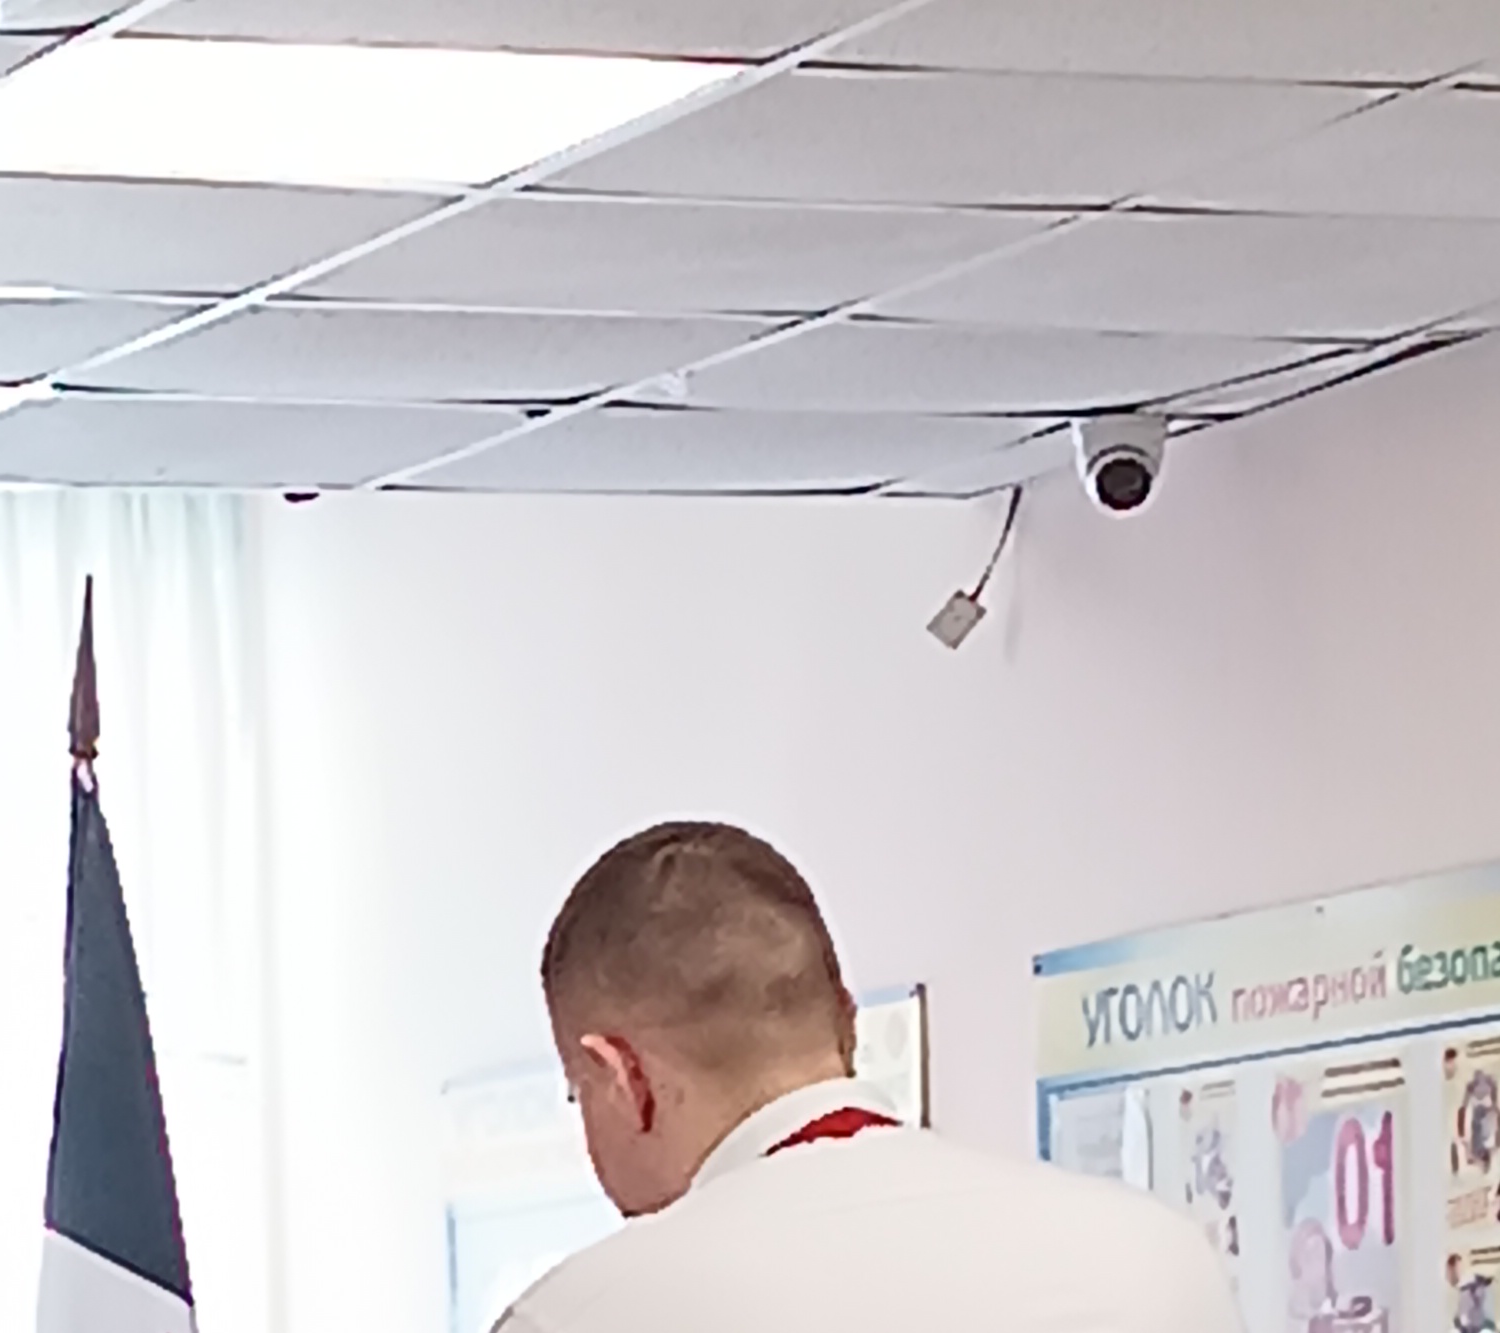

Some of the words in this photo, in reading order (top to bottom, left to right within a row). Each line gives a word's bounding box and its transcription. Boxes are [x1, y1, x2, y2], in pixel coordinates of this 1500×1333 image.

[1082, 970, 1217, 1048] УГОЛОК
[1232, 949, 1387, 1021] пожарной
[1334, 1110, 1395, 1250] 01
